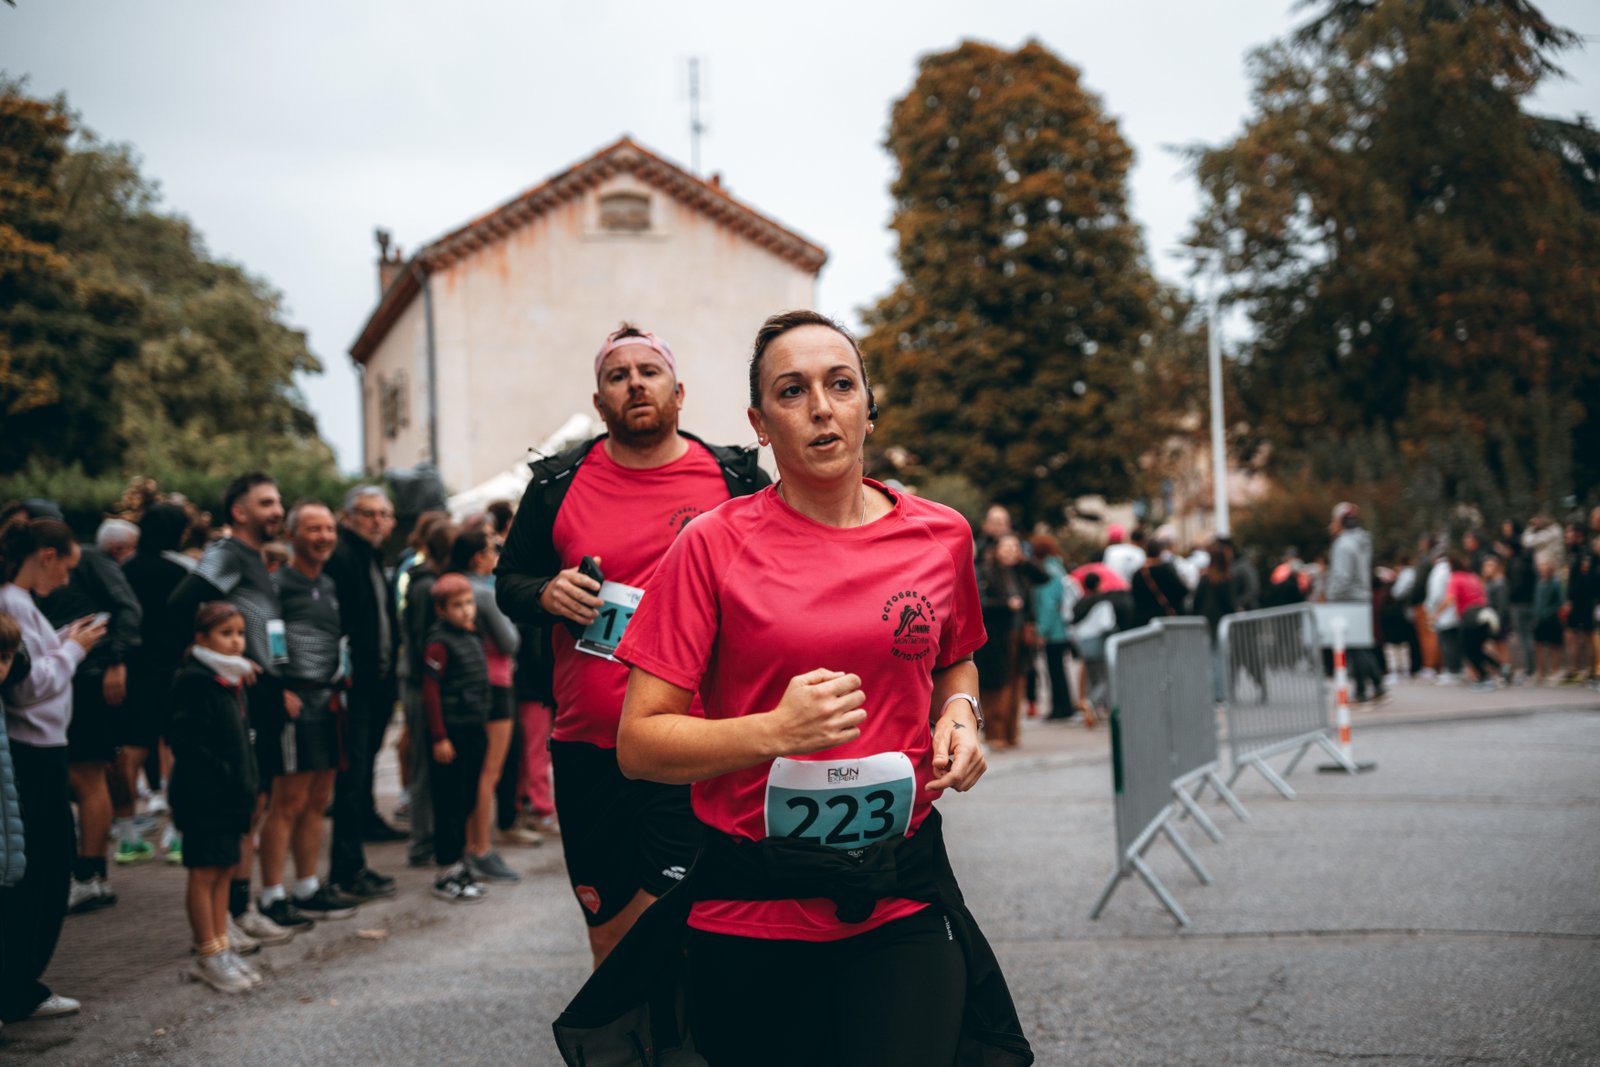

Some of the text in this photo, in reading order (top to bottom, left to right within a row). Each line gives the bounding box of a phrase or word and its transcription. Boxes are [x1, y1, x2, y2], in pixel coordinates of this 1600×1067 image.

[882, 591, 917, 621] OCTOBRE
[601, 608, 634, 642] 1
[786, 790, 895, 845] 223
